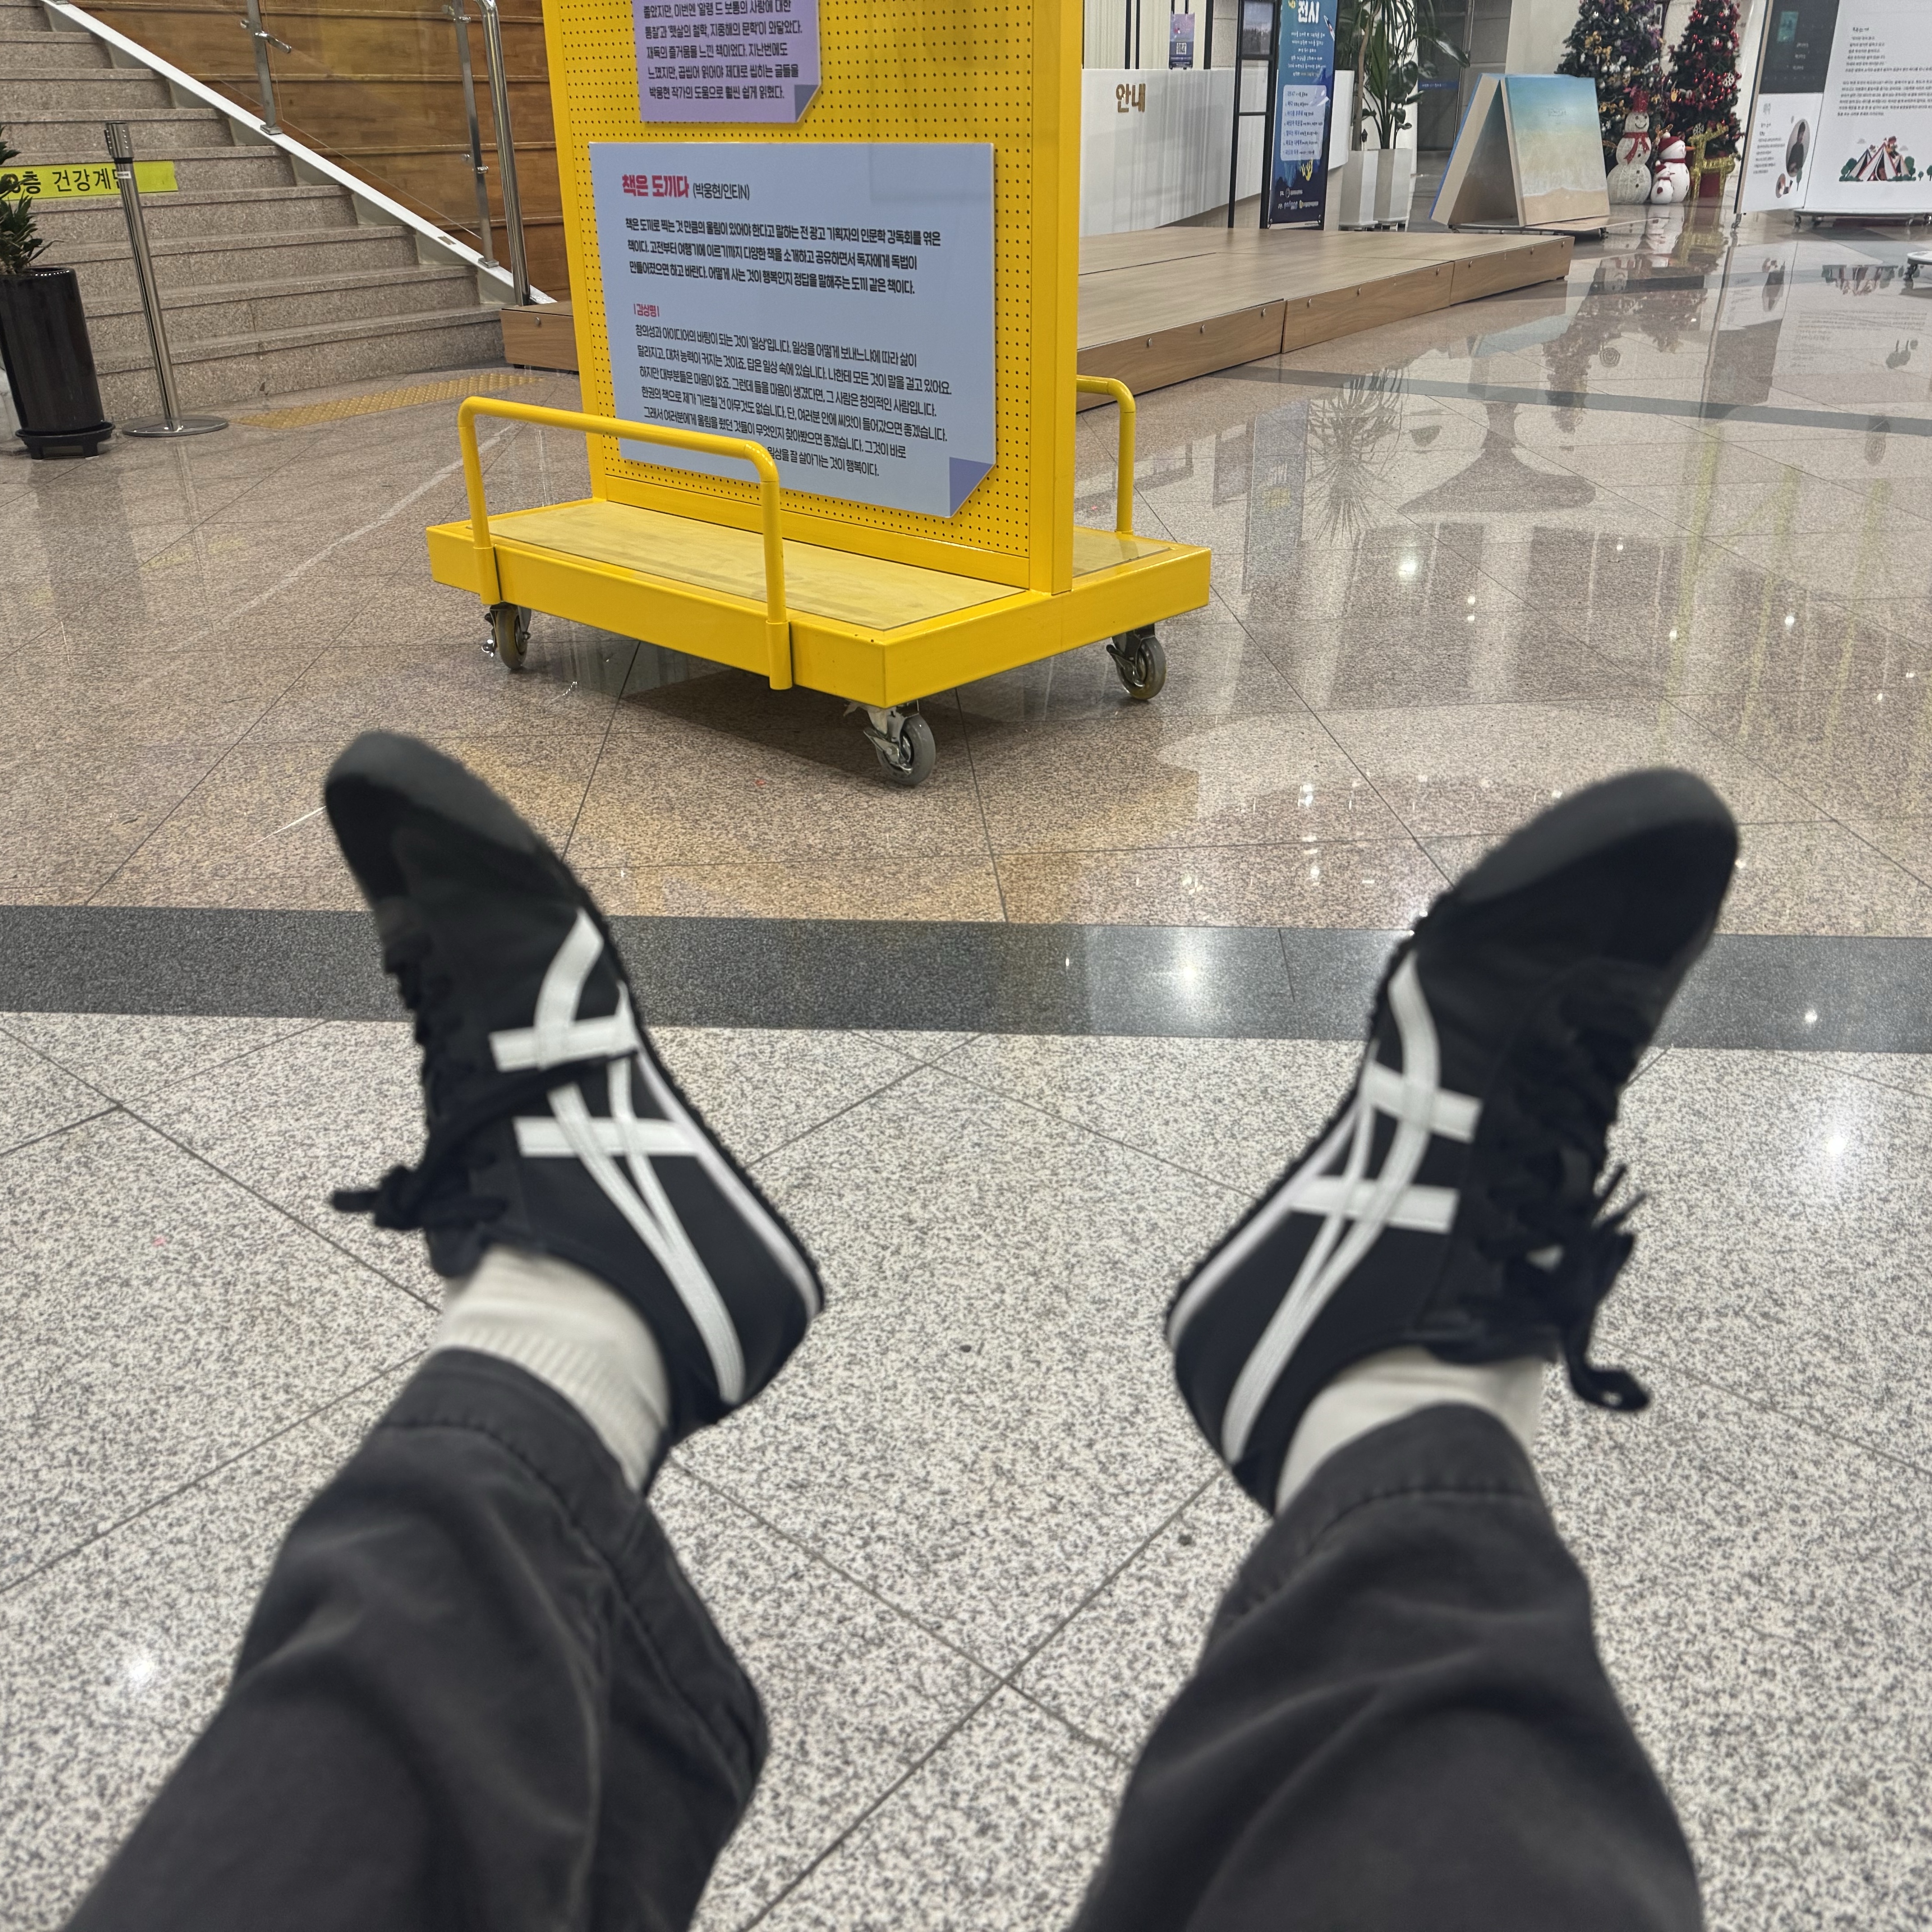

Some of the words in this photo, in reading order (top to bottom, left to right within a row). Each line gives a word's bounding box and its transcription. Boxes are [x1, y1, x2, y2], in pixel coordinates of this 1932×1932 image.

[643, 4, 673, 19] 좋았지만,
[674, 2, 696, 17] 이번엔
[715, 1, 723, 15] 드
[724, 0, 749, 15] 보통의
[750, 0, 774, 14] 사랑에
[773, 0, 792, 13] 대한
[1298, 0, 1320, 23] 전시
[692, 23, 709, 38] 철학,
[709, 22, 741, 37] 지중해의
[646, 46, 667, 59] 재독의
[668, 45, 697, 59] 즐거움을
[699, 44, 714, 58] 느낀
[715, 43, 747, 57] 책이었다.
[748, 42, 788, 57] 지난번에도
[648, 66, 677, 80] 느꼈지만,
[678, 65, 700, 79] 곱씹어
[701, 65, 724, 79] 읽어야
[725, 64, 748, 78] 제대로
[749, 63, 773, 78] 씹히는
[774, 63, 799, 78] 글들을
[649, 86, 670, 99] 박웅현
[671, 86, 693, 99] 작가의
[694, 85, 724, 99] 도움으로
[725, 85, 741, 99] 훨씬
[741, 85, 758, 99] 쉽게
[759, 85, 784, 99] 읽혔다.
[1116, 83, 1145, 113] 안내
[52, 169, 120, 192] 건강계
[621, 174, 649, 197] 책은
[651, 175, 690, 198] 도끼다
[625, 217, 639, 231] 책은
[639, 218, 661, 232] 도끼로
[660, 219, 675, 233] 찍는
[705, 221, 728, 235] 울림이
[728, 222, 752, 237] 있어야
[751, 223, 775, 238] 한다고
[775, 224, 799, 239] 말하는
[800, 225, 809, 240] 전
[809, 225, 826, 240] 광고
[826, 226, 860, 242] 기획자의
[860, 228, 886, 244] 인문학
[887, 229, 922, 246] 강독회를
[923, 230, 941, 246] 엮은
[627, 239, 650, 253] 책이다.
[649, 240, 677, 255] 고전부터
[677, 242, 706, 257] 여행기에
[706, 244, 743, 259] 이르기까지
[743, 246, 766, 261] 다양한
[766, 247, 782, 262] 책을
[783, 248, 815, 264] 소개하고
[815, 249, 856, 267] 공유하면서
[856, 252, 890, 268] 독자에게
[891, 254, 917, 270] 독법이
[629, 261, 670, 276] 만들어졌으면
[669, 263, 685, 277] 하고
[684, 264, 708, 279] 바란다.
[708, 266, 730, 281] 어떻게
[731, 267, 746, 282] 사는
[746, 268, 762, 283] 것이
[762, 270, 793, 285] 행복인지
[793, 272, 817, 288] 정답을
[818, 273, 851, 290] 말해주는
[851, 276, 868, 291] 도끼
[869, 277, 886, 293] 같은
[887, 278, 915, 294] 책이다.
[635, 324, 662, 339] 창의성과
[662, 327, 696, 343] 아이디어의
[696, 330, 718, 345] 바탕이
[718, 333, 733, 347] 되는
[733, 334, 749, 349] 것이
[749, 336, 791, 354] '일상'입니다.
[791, 340, 815, 356] 일상을
[815, 343, 840, 359] 어떻게
[840, 345, 881, 363] 보내느냐에
[881, 350, 899, 366] 따라
[899, 352, 917, 368] 삶이
[665, 348, 680, 362] 대처
[680, 350, 701, 364] 능력이
[701, 352, 723, 367] 커지는
[762, 359, 778, 374] 일상
[778, 361, 794, 376] 속에
[794, 363, 828, 380] 있습니다.
[828, 367, 852, 383] 나한테
[852, 370, 869, 386] 모든
[869, 372, 887, 388] 것이
[887, 374, 905, 390] 말을
[905, 376, 923, 392] 걸고
[923, 378, 952, 395] 있어요.
[639, 365, 659, 380] 하지만
[659, 368, 693, 384] 대부분들은
[693, 373, 715, 387] 마음이
[731, 377, 754, 392] 그런데
[754, 380, 769, 395] 들을
[769, 382, 792, 398] 마음이
[792, 385, 825, 403] 생겼다면,
[826, 390, 834, 403] 그
[835, 391, 859, 407] 사람은
[859, 394, 892, 412] 창의적인
[893, 398, 937, 417] 사람입니다.
[641, 385, 662, 400] 한권의
[661, 388, 682, 403] 책으로
[681, 391, 696, 405] 제가
[696, 393, 718, 409] 가르칠
[718, 396, 726, 410] 건
[726, 398, 755, 414] 아무것도
[755, 402, 787, 419] 없습니다.
[797, 408, 820, 424] 여러분
[821, 411, 837, 426] 안에
[837, 414, 861, 430] 씨앗이
[862, 417, 903, 436] 들어갔으면
[903, 423, 948, 442] 좋겠습니다.
[643, 406, 663, 421] 그래서
[663, 409, 697, 426] 여러분에게
[697, 414, 718, 429] 울림을
[718, 417, 733, 432] 줬던
[733, 419, 755, 435] 것들이
[755, 423, 785, 440] 무엇인지
[785, 427, 823, 446] 찾아봤으면
[823, 433, 864, 452] 좋겠습니다.
[865, 440, 889, 456] 그것이
[889, 443, 906, 459] 바로
[790, 450, 798, 463] 잘
[798, 451, 829, 469] 살아가는
[829, 456, 845, 471] 것이
[846, 459, 879, 477] 행복이다.
